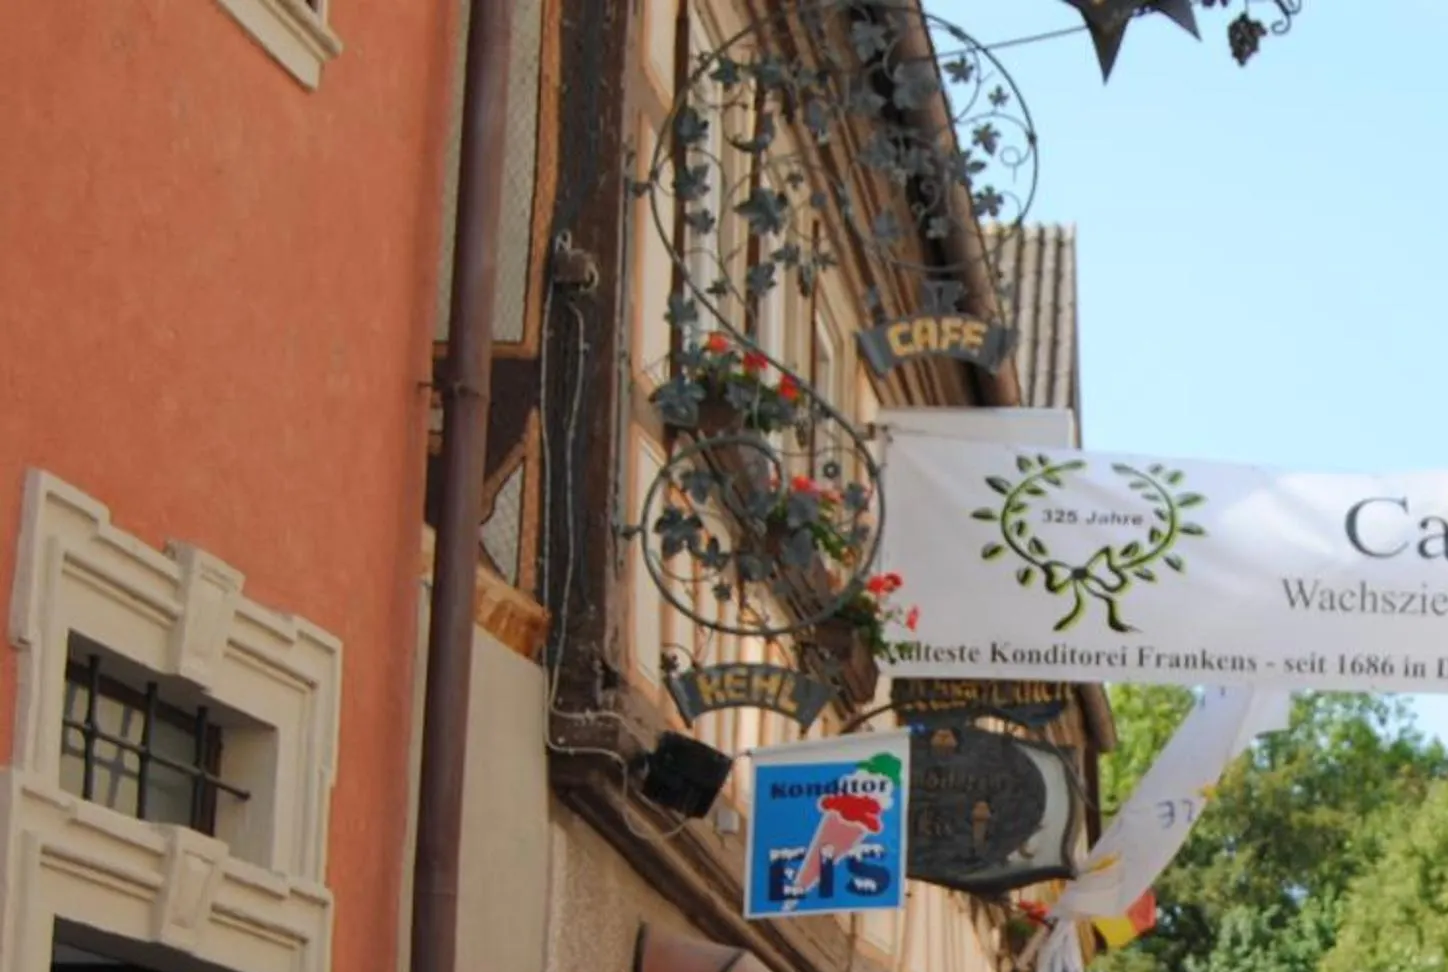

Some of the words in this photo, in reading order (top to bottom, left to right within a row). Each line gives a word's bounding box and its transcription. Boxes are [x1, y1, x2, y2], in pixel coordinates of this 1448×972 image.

[1042, 508, 1078, 524] 325
[1085, 509, 1143, 526] Jahre
[990, 642, 1127, 668] Konditorei
[1137, 646, 1257, 672] Frankens
[1284, 652, 1326, 674] seit
[1338, 653, 1395, 676] 1686
[1403, 656, 1426, 679] in
[770, 778, 888, 800] Konditor
[768, 845, 892, 901] EIS
